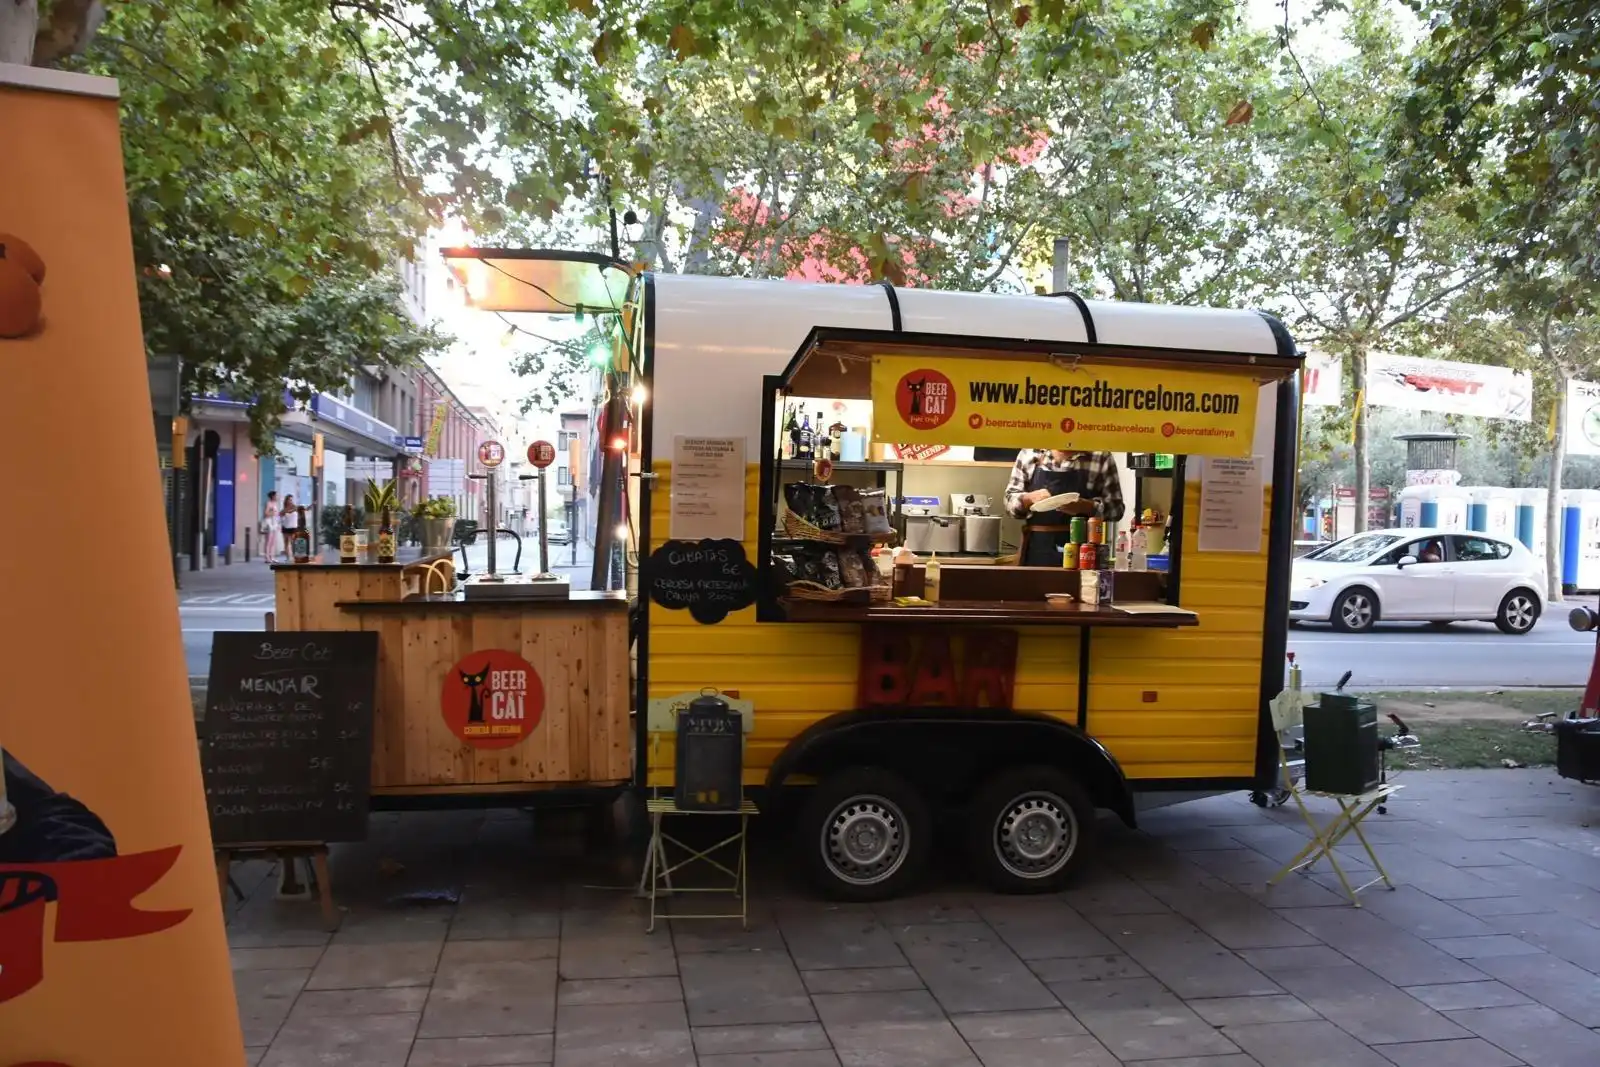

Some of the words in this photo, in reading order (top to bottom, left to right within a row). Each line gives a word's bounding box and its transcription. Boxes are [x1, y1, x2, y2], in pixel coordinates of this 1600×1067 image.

[926, 382, 947, 395] BEER
[969, 377, 1240, 415] www.beercatbarcelona.com
[925, 396, 947, 414] CAT
[985, 418, 1052, 431] beercatalunya
[1076, 422, 1155, 435] beercatbarcelona
[1175, 426, 1235, 438] beercatalunya
[722, 563, 741, 576] 6€
[254, 642, 299, 660] Beer
[301, 642, 332, 661] Cat
[860, 626, 1018, 708] BAR
[240, 675, 321, 698] MENJAR
[491, 670, 527, 690] BEER
[491, 691, 528, 720] CAT
